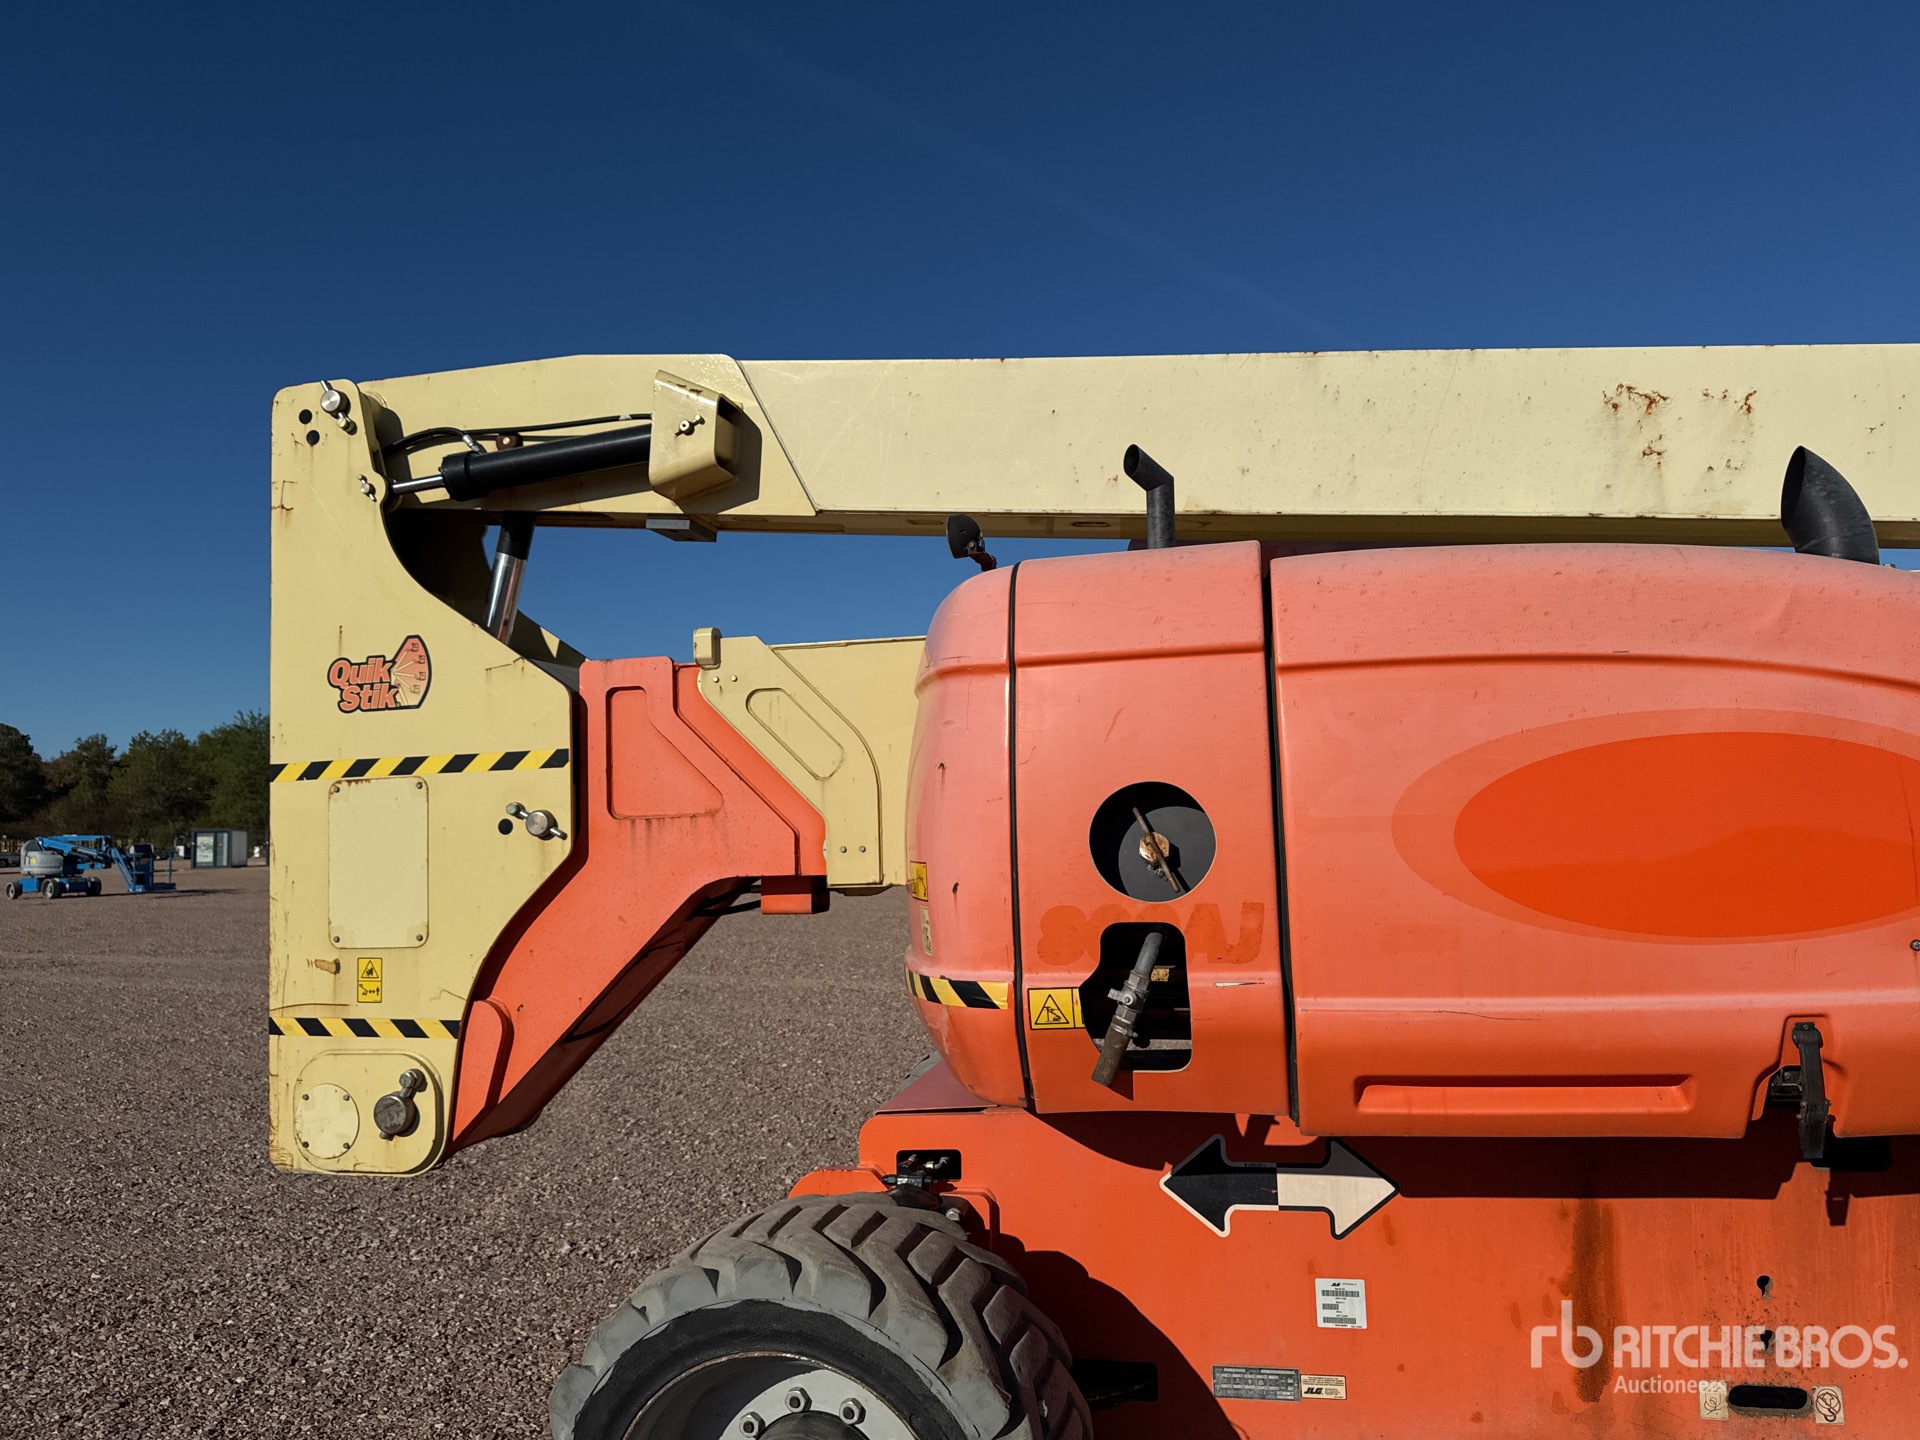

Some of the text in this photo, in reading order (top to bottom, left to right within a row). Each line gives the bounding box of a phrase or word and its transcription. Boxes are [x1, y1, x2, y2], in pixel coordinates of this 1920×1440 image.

[329, 657, 393, 689] Quik
[339, 683, 398, 711] Stik
[1304, 1387, 1322, 1395] JLG
